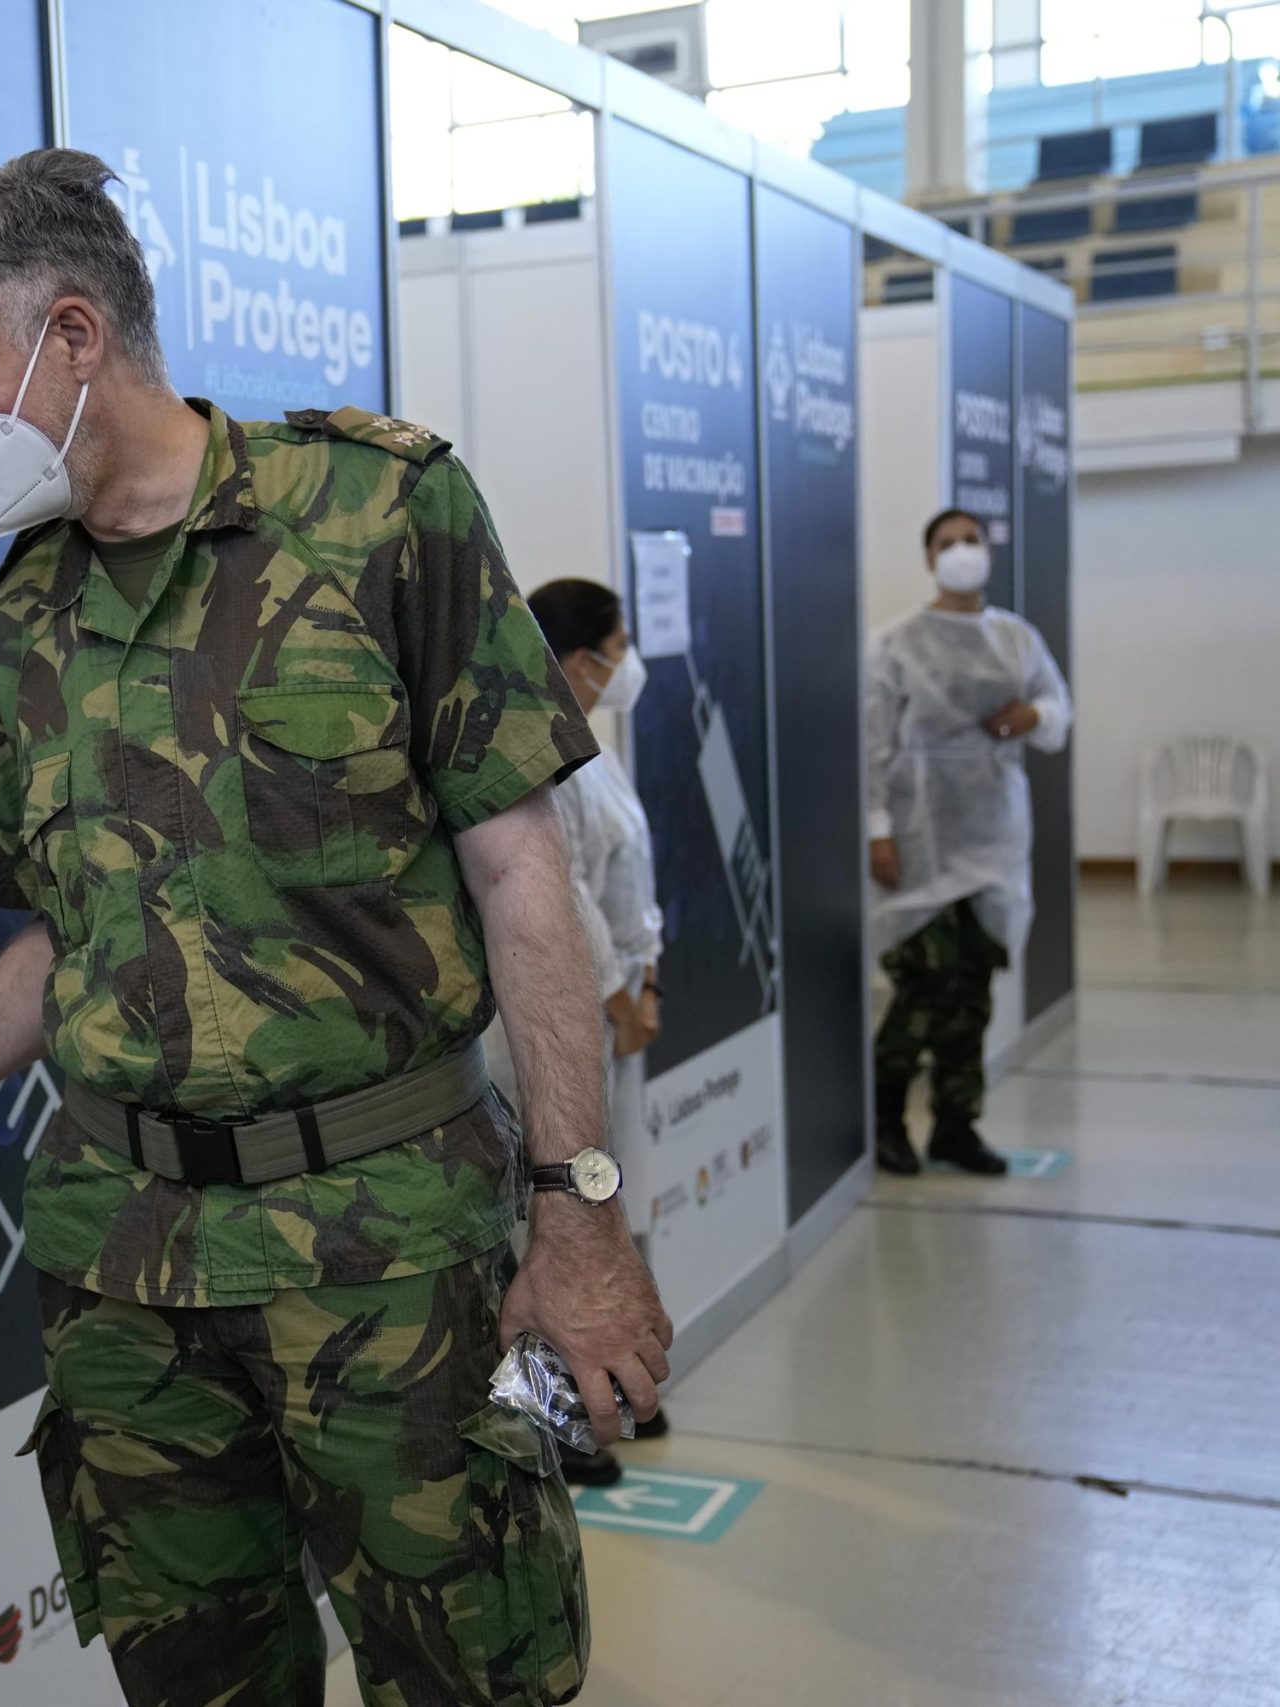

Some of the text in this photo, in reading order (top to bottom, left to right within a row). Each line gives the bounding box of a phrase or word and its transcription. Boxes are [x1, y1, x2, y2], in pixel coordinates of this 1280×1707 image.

[195, 160, 347, 277] Lisboa
[199, 258, 373, 387] Protege
[638, 310, 722, 390] POSTO
